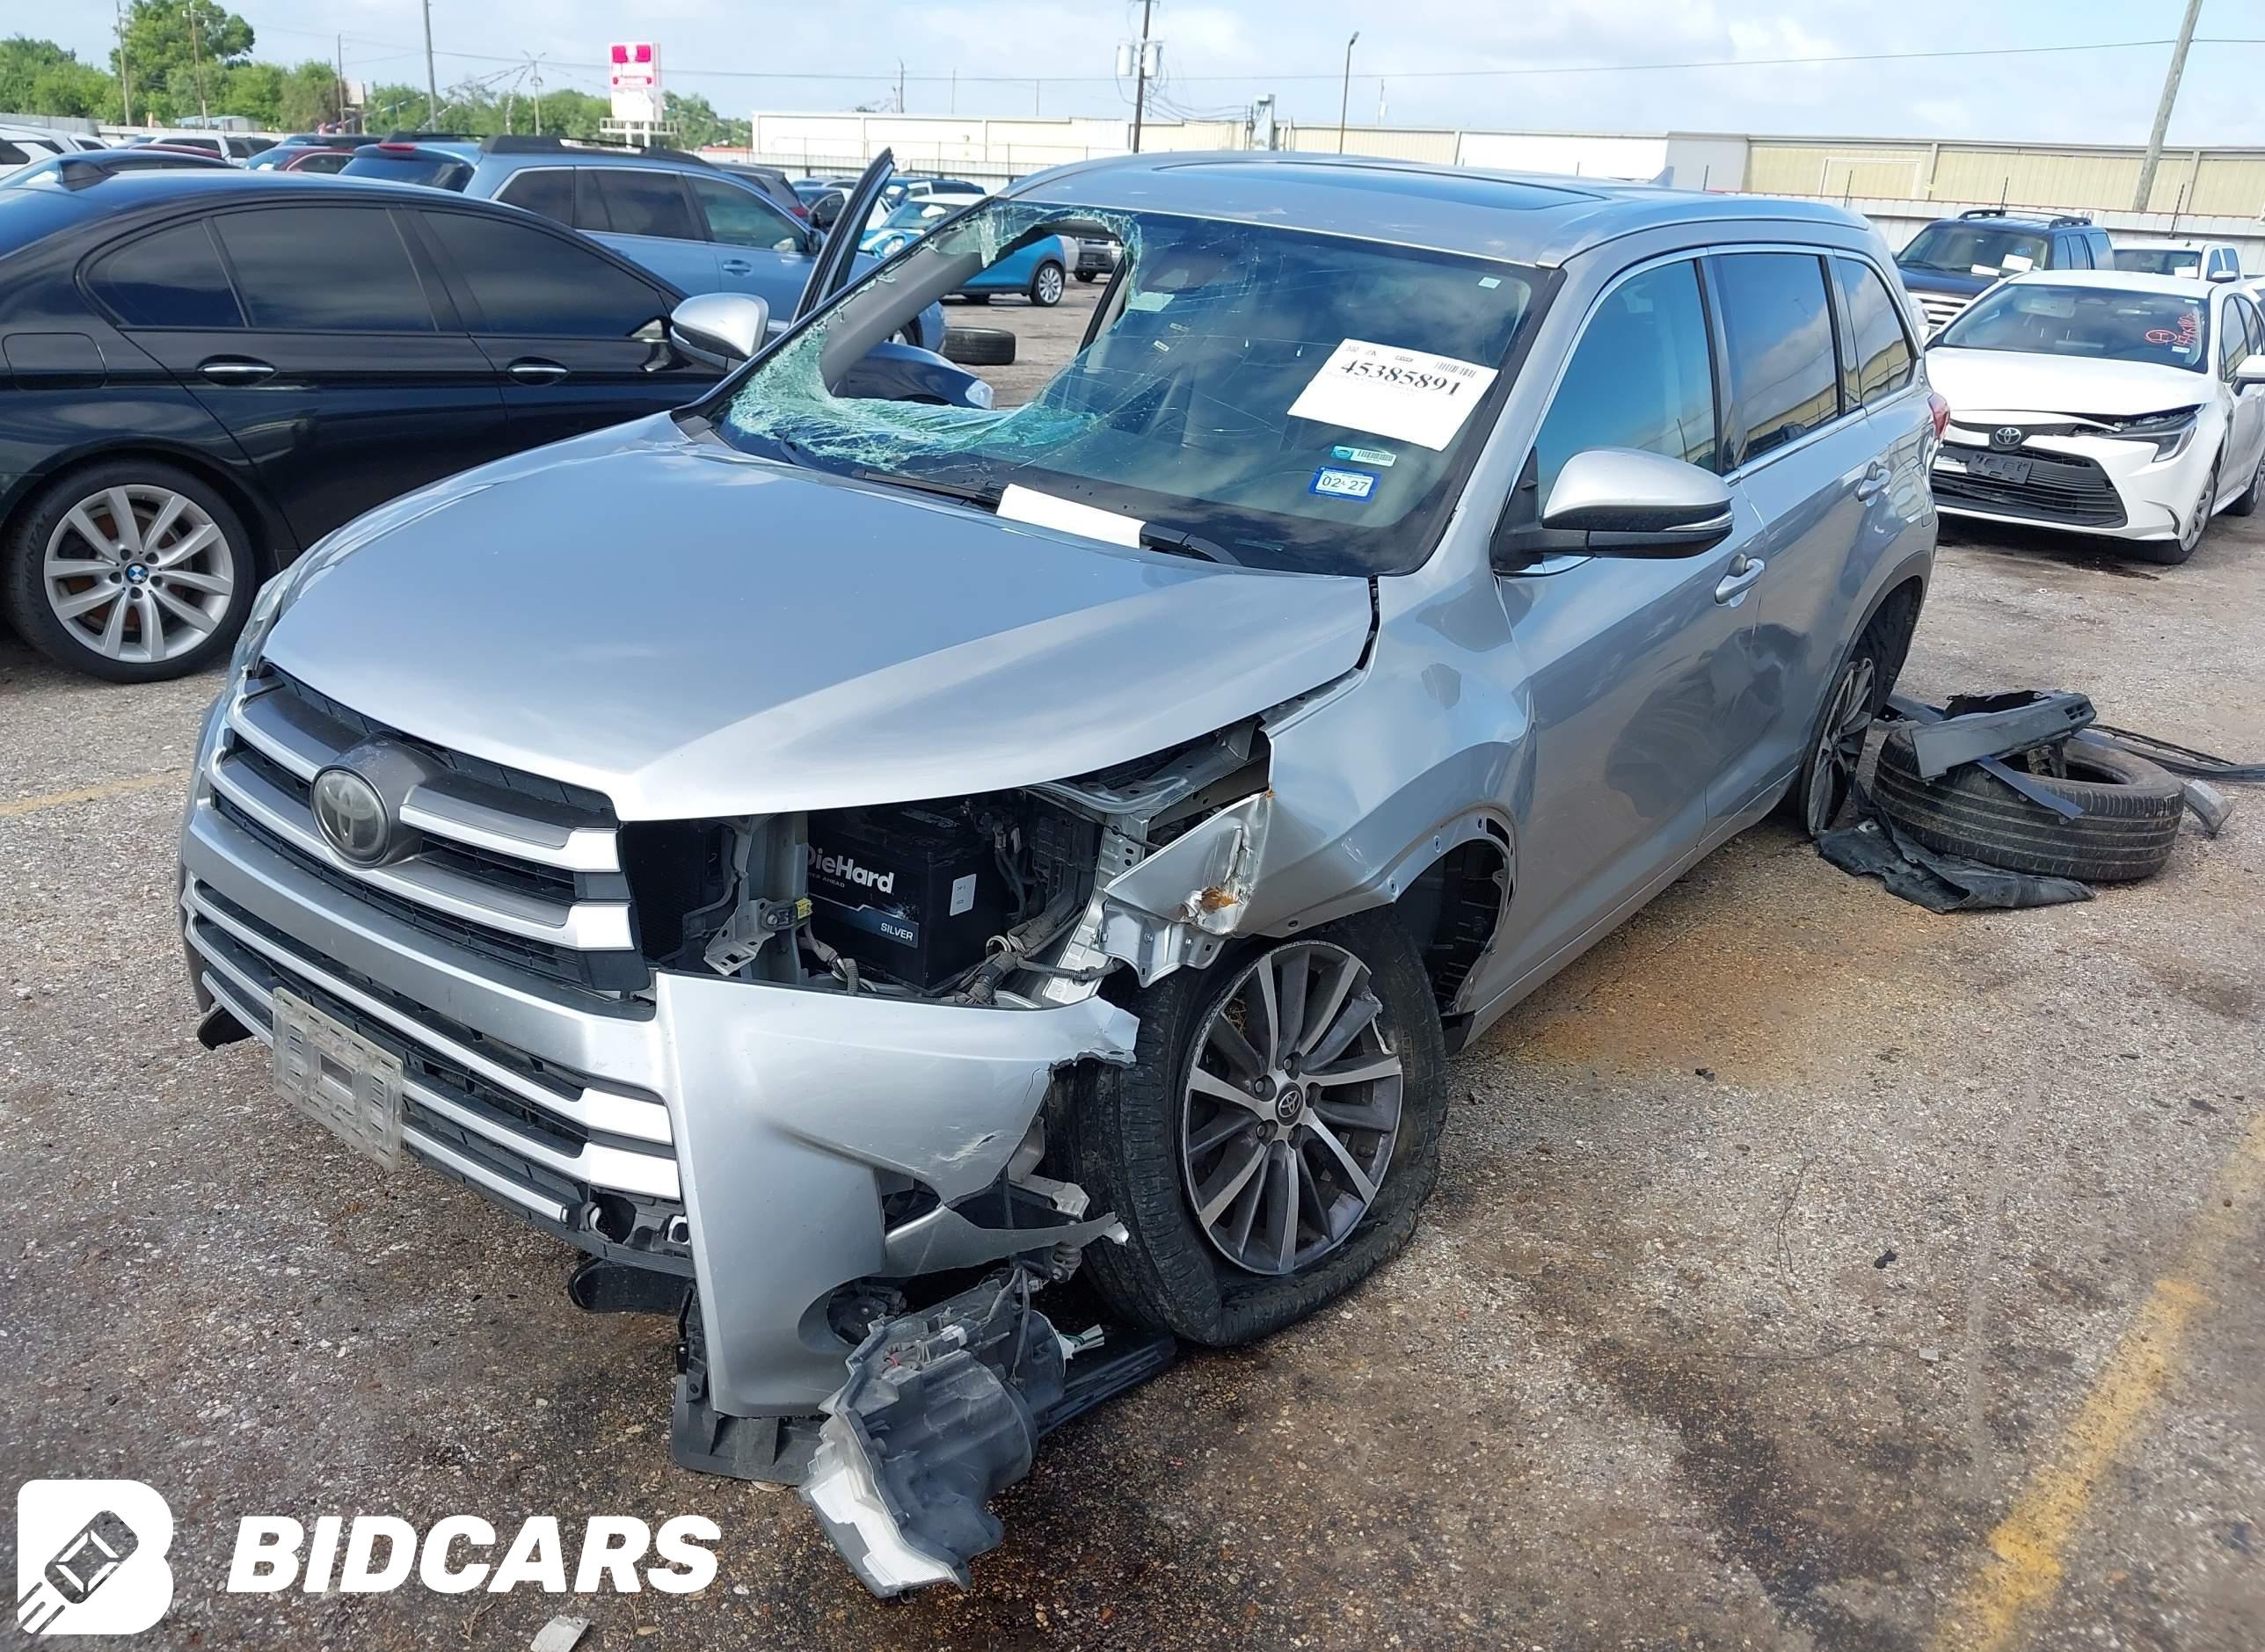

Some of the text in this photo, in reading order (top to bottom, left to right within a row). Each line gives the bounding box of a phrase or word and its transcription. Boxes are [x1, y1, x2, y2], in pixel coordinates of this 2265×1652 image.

[1340, 359, 1461, 397] 45385891
[1322, 476, 1369, 491] 02 27
[880, 922, 914, 942] SILVER
